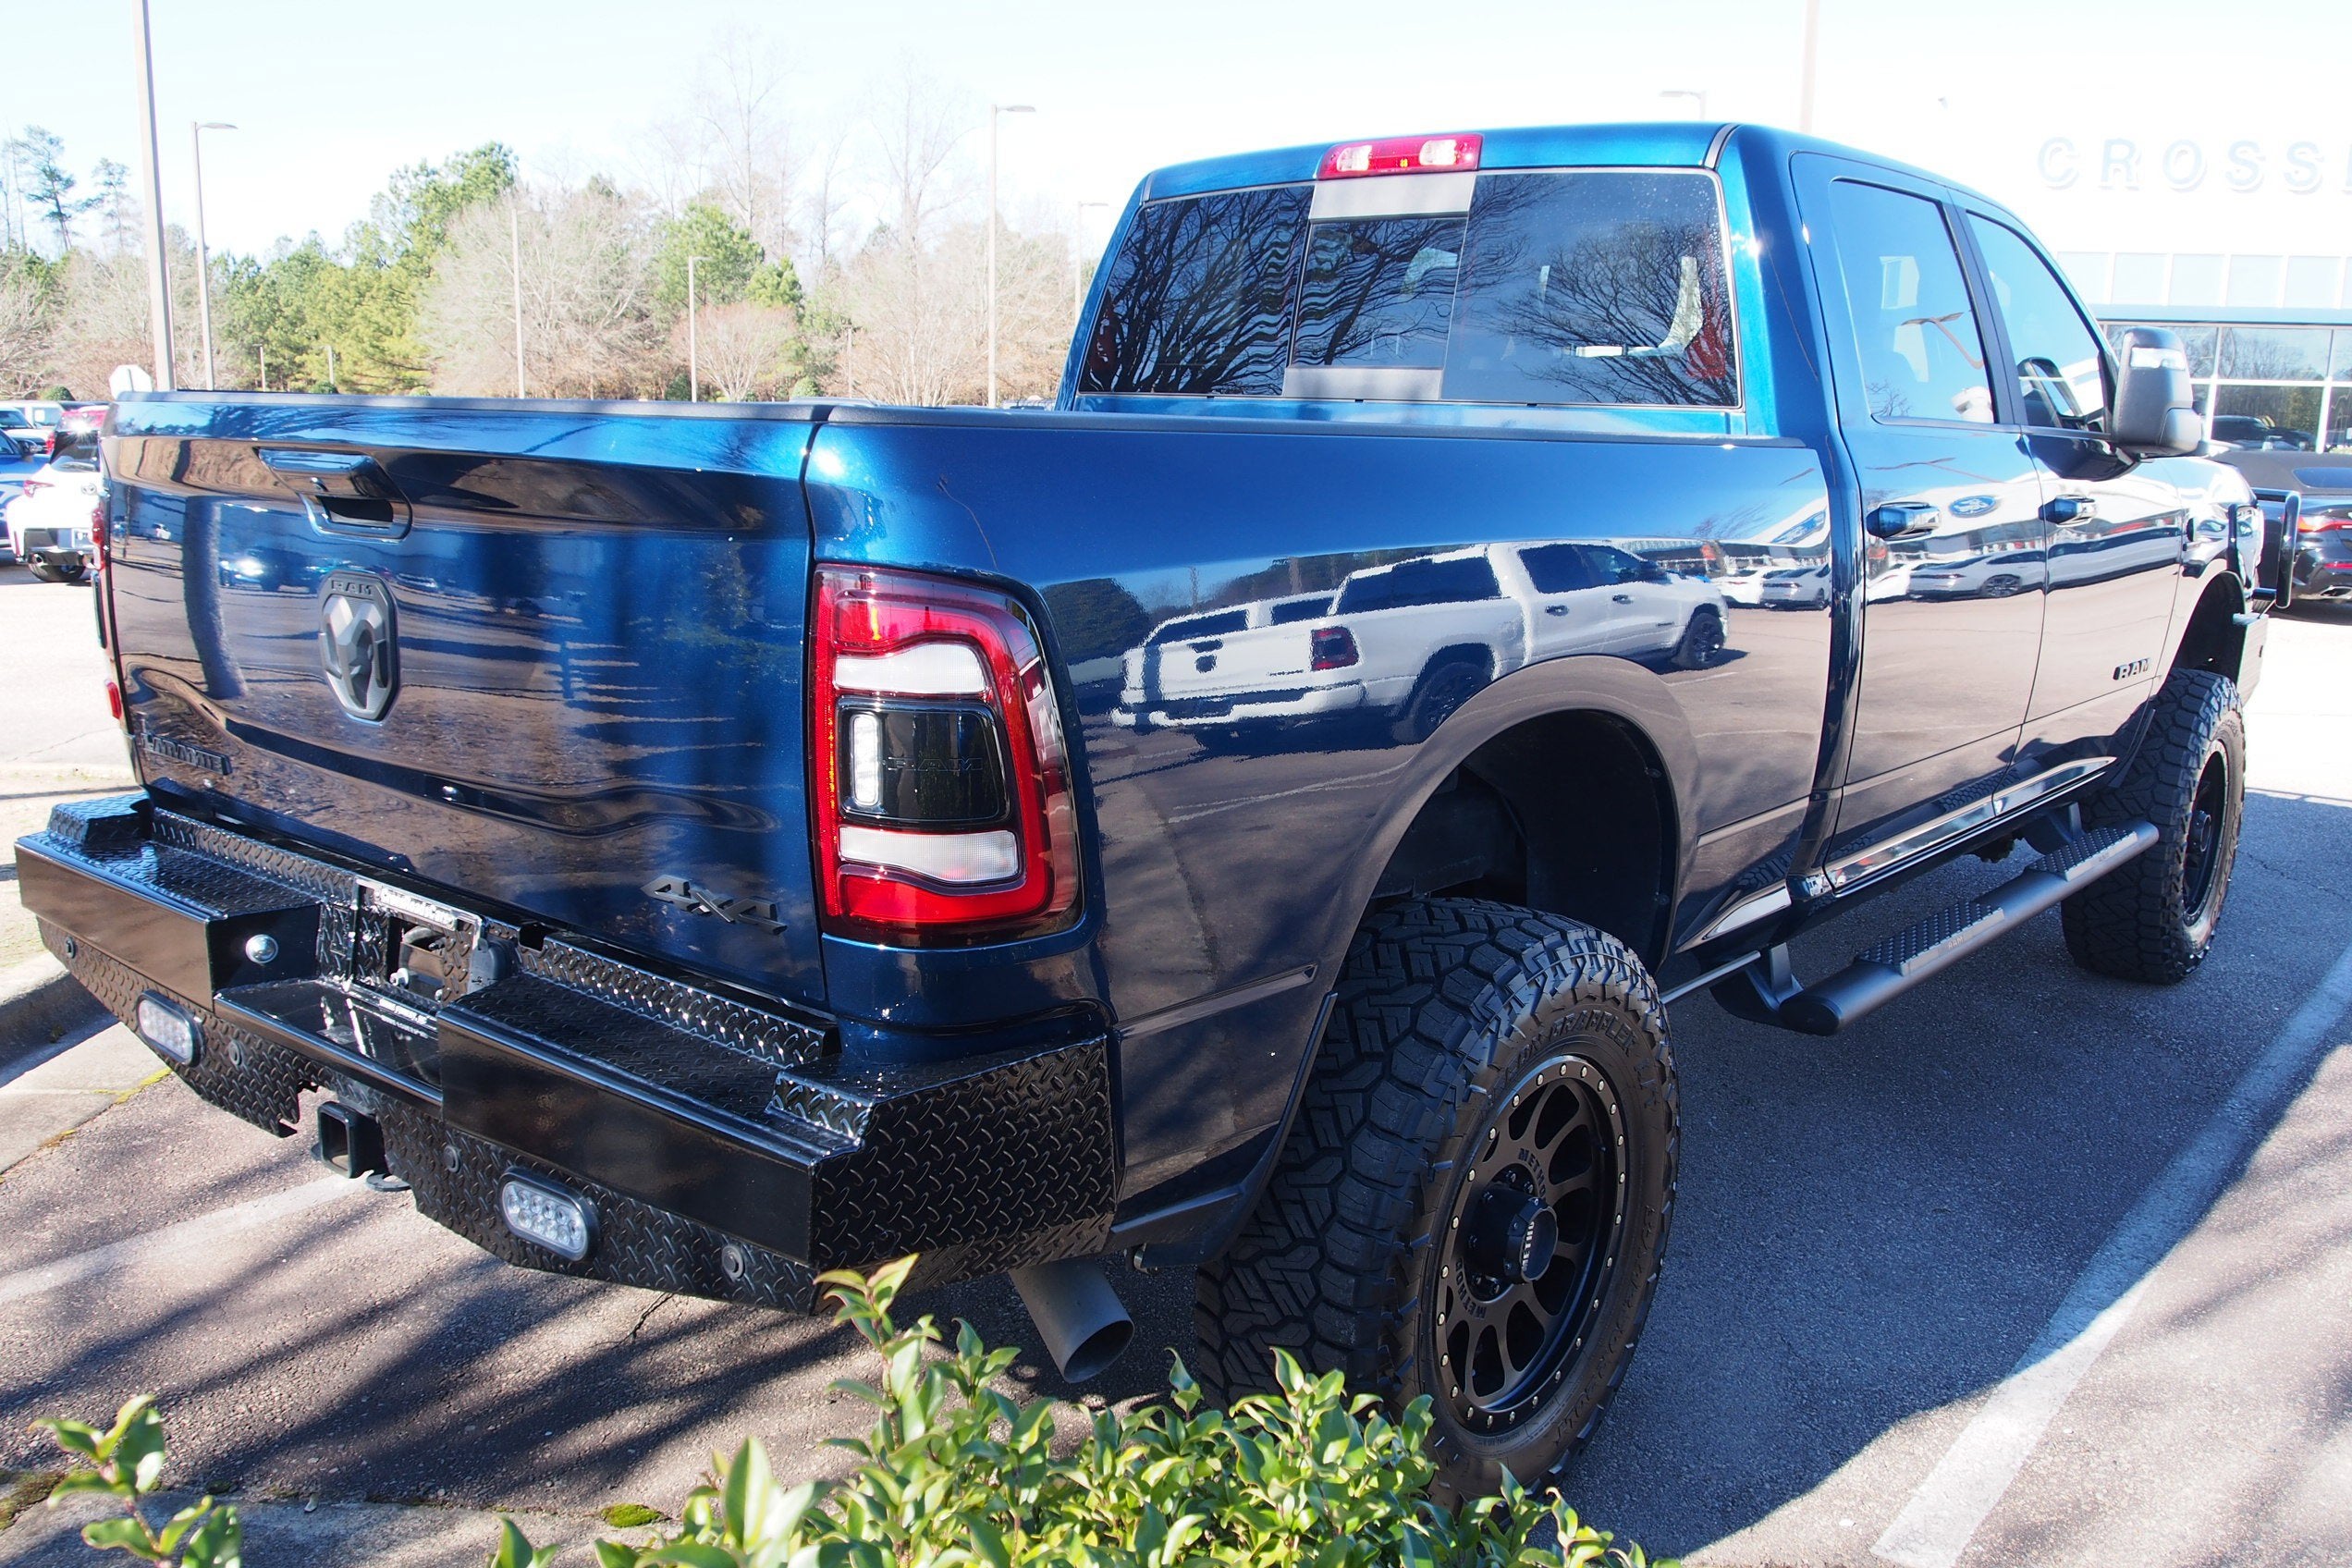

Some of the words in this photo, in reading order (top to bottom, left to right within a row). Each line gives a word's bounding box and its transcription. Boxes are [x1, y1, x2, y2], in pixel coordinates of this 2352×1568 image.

[2038, 136, 2352, 195] CROSS
[331, 579, 374, 596] RAM
[2113, 657, 2151, 680] RAM
[887, 756, 984, 772] RAM
